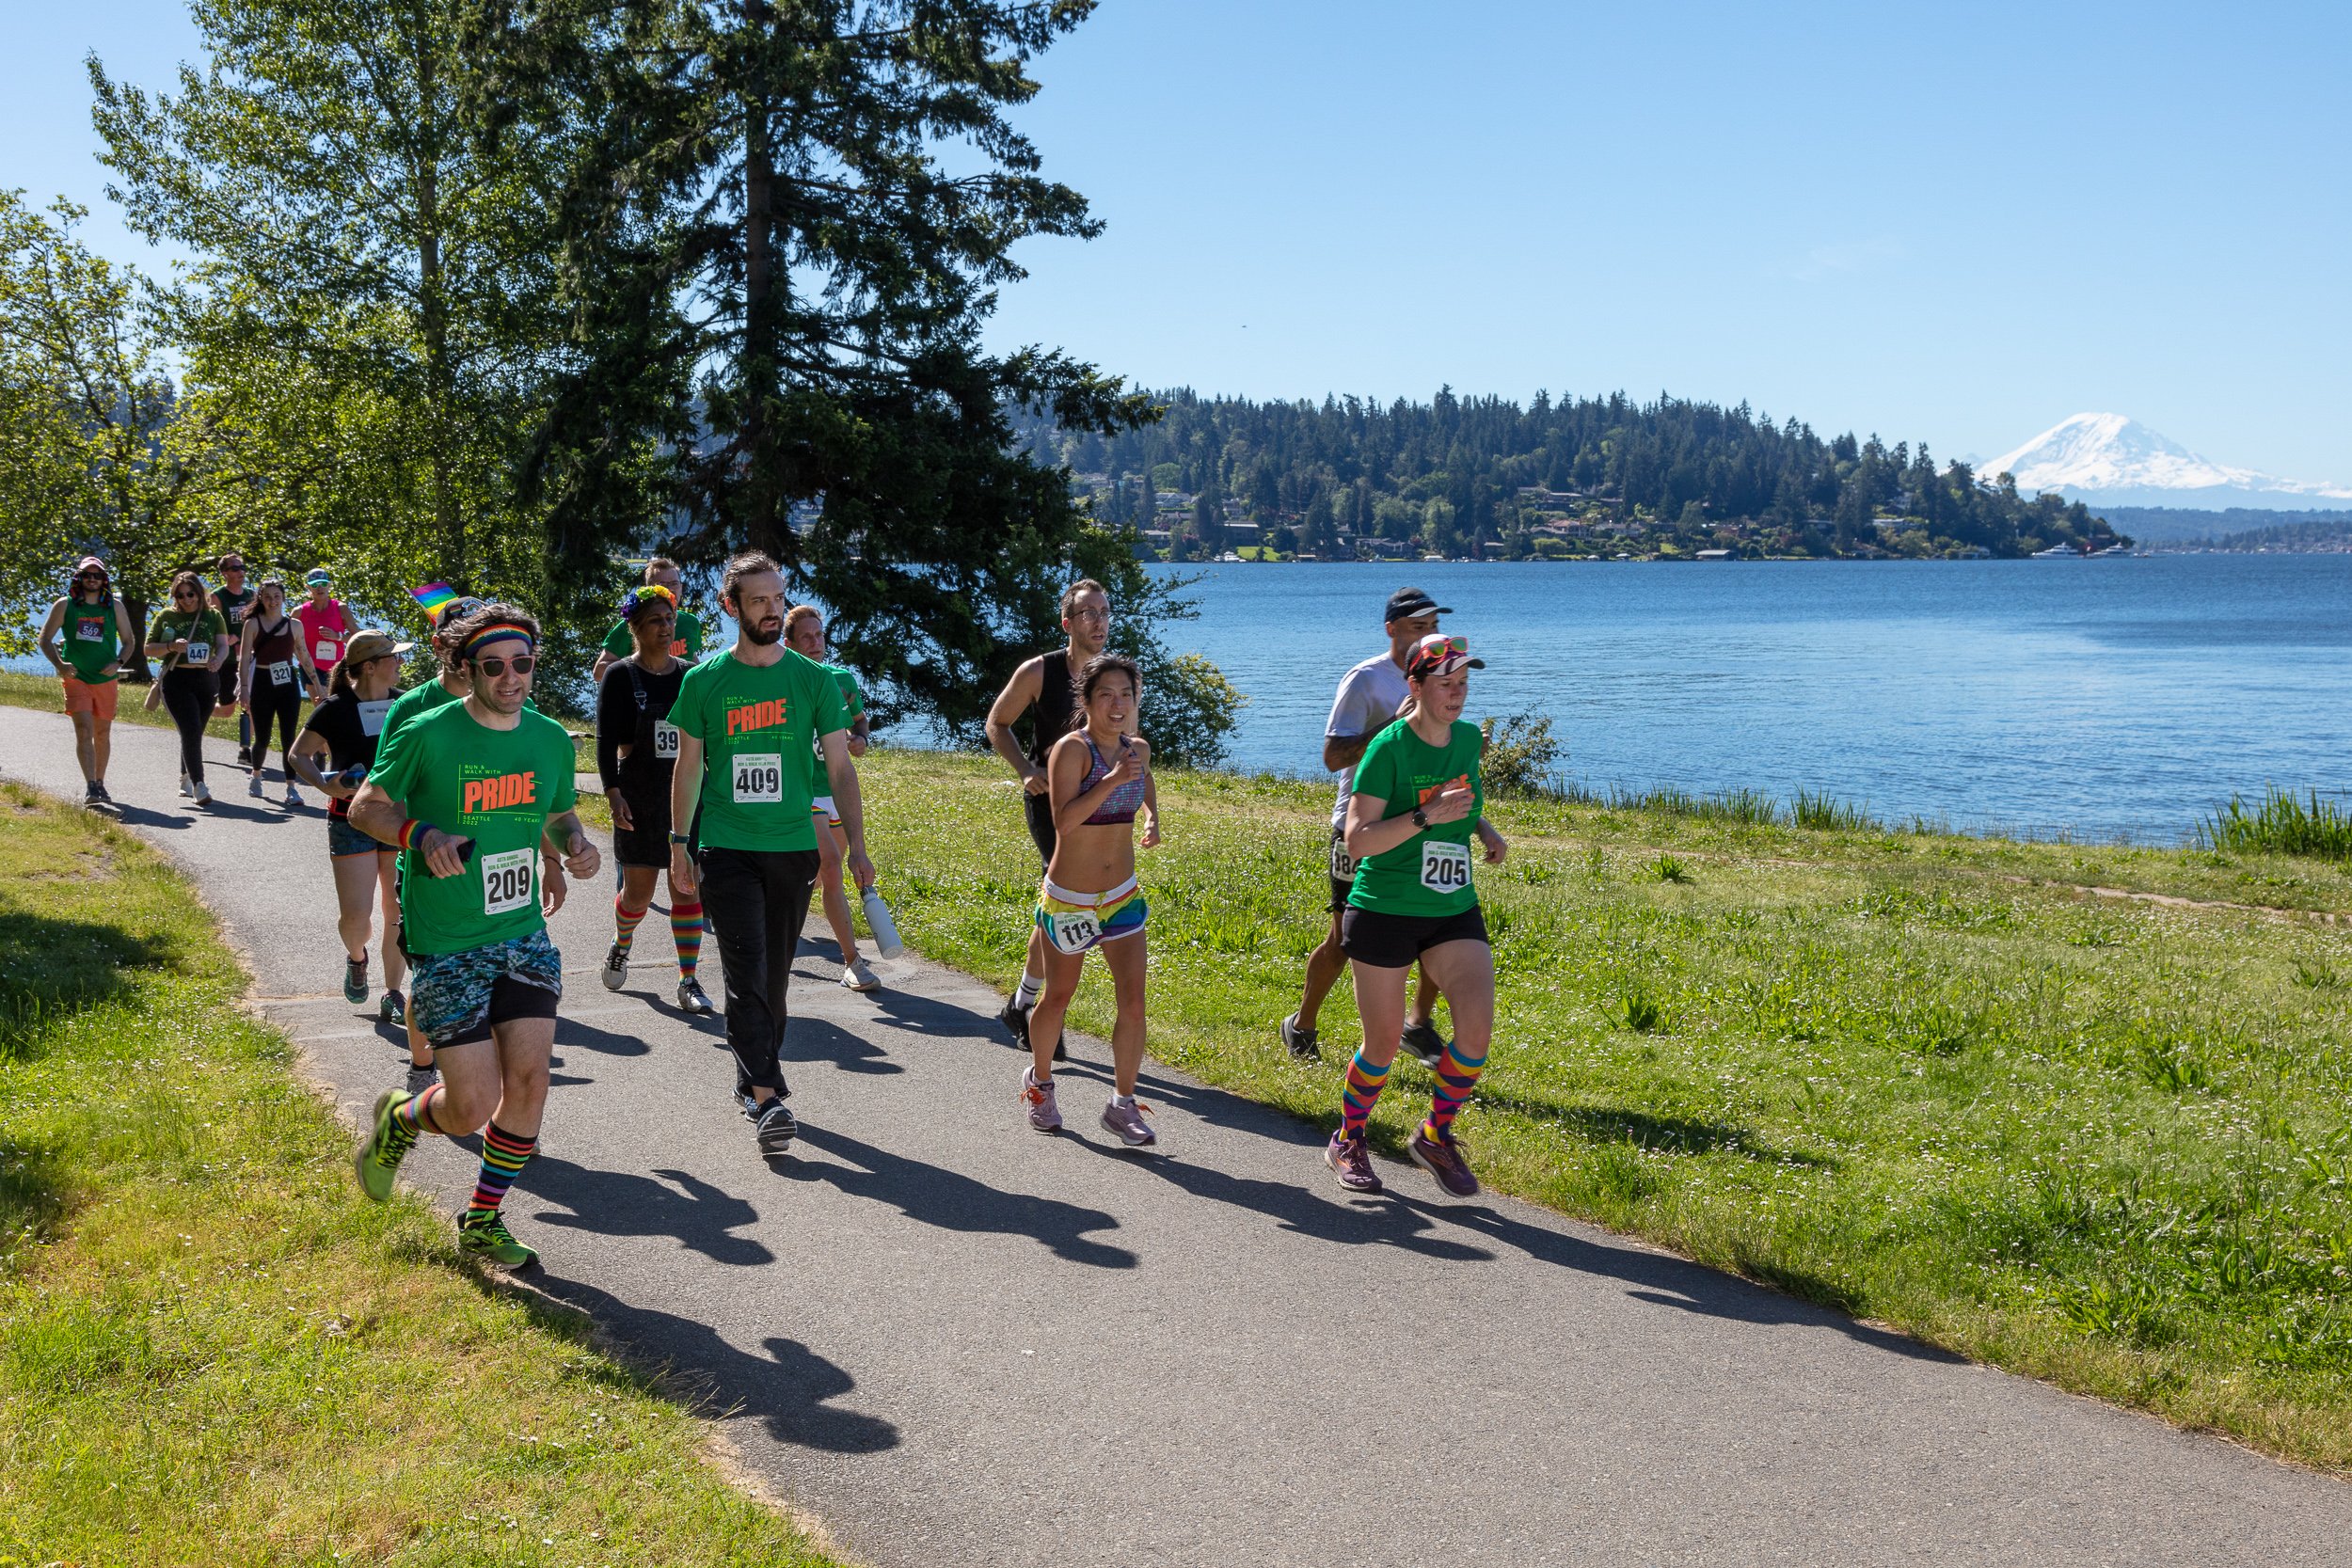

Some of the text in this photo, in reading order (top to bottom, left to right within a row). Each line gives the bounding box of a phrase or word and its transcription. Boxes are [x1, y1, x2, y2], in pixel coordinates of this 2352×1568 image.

[82, 626, 99, 636] 569
[189, 649, 208, 659] 447
[669, 638, 688, 657] IDE
[273, 667, 291, 681] 321
[727, 698, 787, 736] PRIDE
[658, 731, 679, 751] 39
[464, 771, 536, 814] PRIDE
[736, 768, 779, 793] 409
[1425, 857, 1467, 885] 205
[487, 865, 530, 904] 209
[1062, 921, 1095, 945] 113
